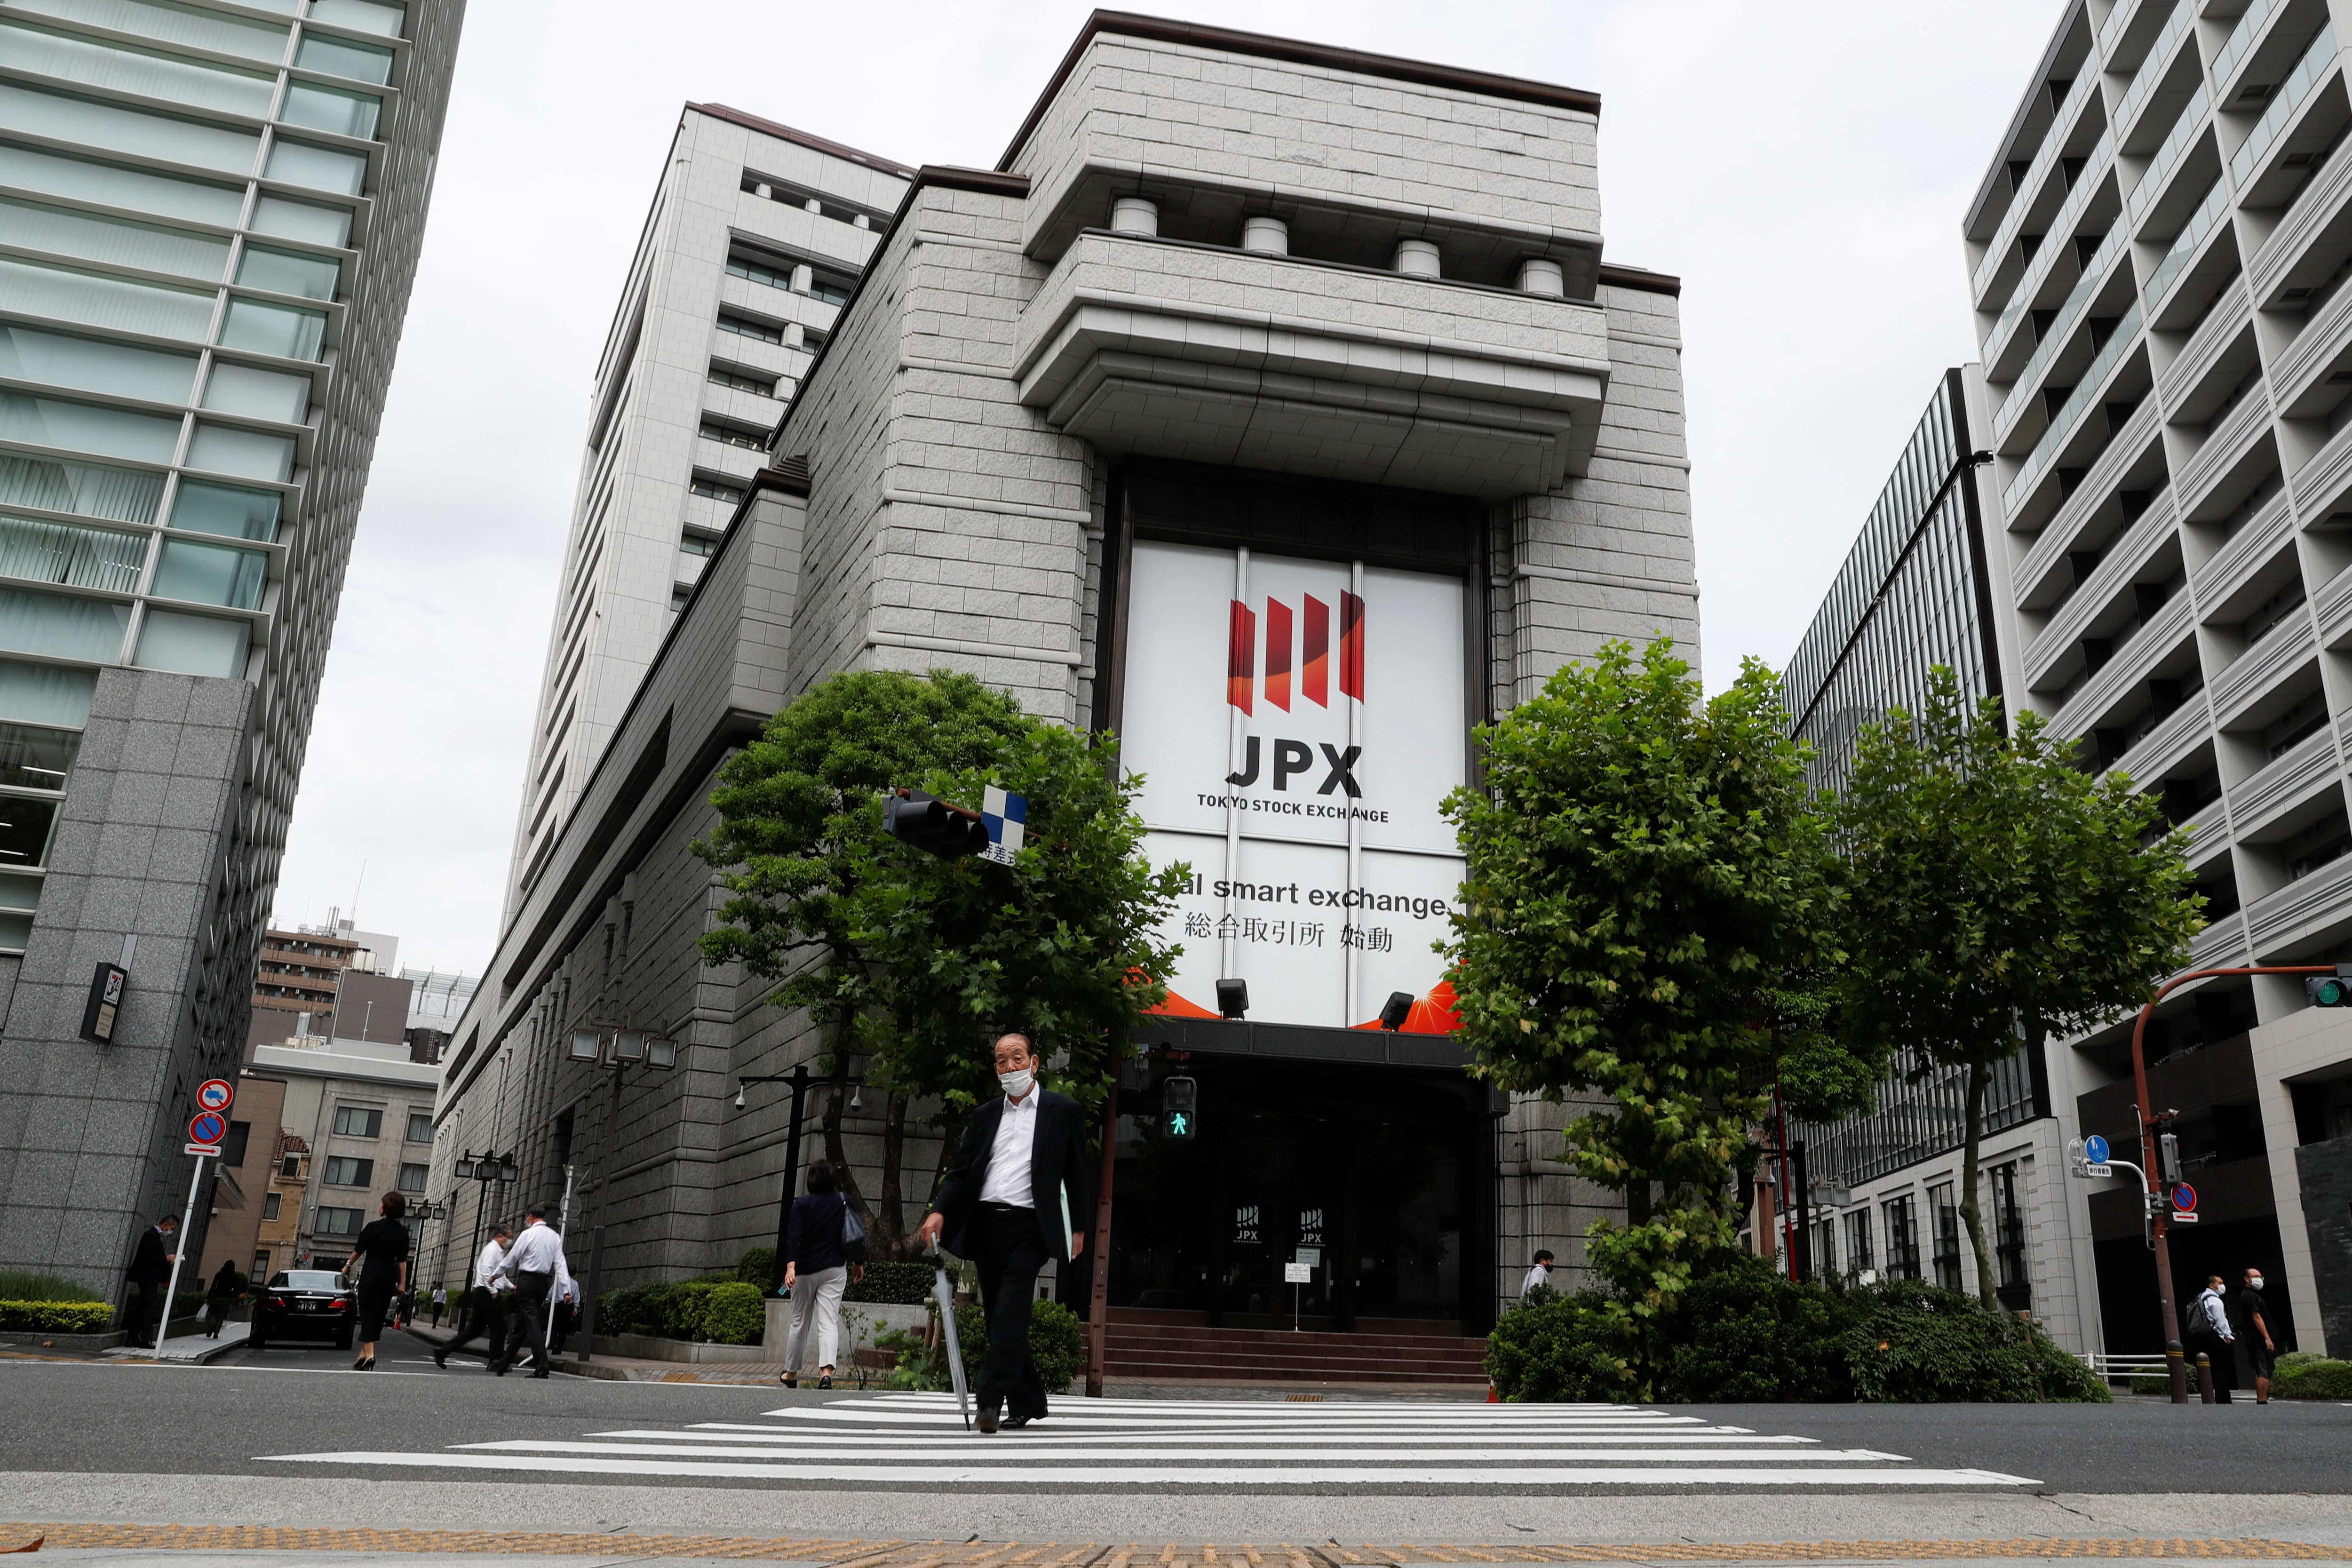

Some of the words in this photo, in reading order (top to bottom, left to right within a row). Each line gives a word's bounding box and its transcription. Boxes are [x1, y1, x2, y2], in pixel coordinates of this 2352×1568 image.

[1224, 736, 1362, 799] JPX
[1197, 794, 1248, 810] TOKYO
[1253, 799, 1302, 815] STOCK
[1306, 804, 1389, 823] EXCHANGE
[1213, 880, 1299, 904] smart
[1184, 911, 1325, 947] 総合取引所
[1340, 923, 1393, 953] 始動
[1237, 1230, 1258, 1240] JPX
[1301, 1233, 1322, 1243] JPX
